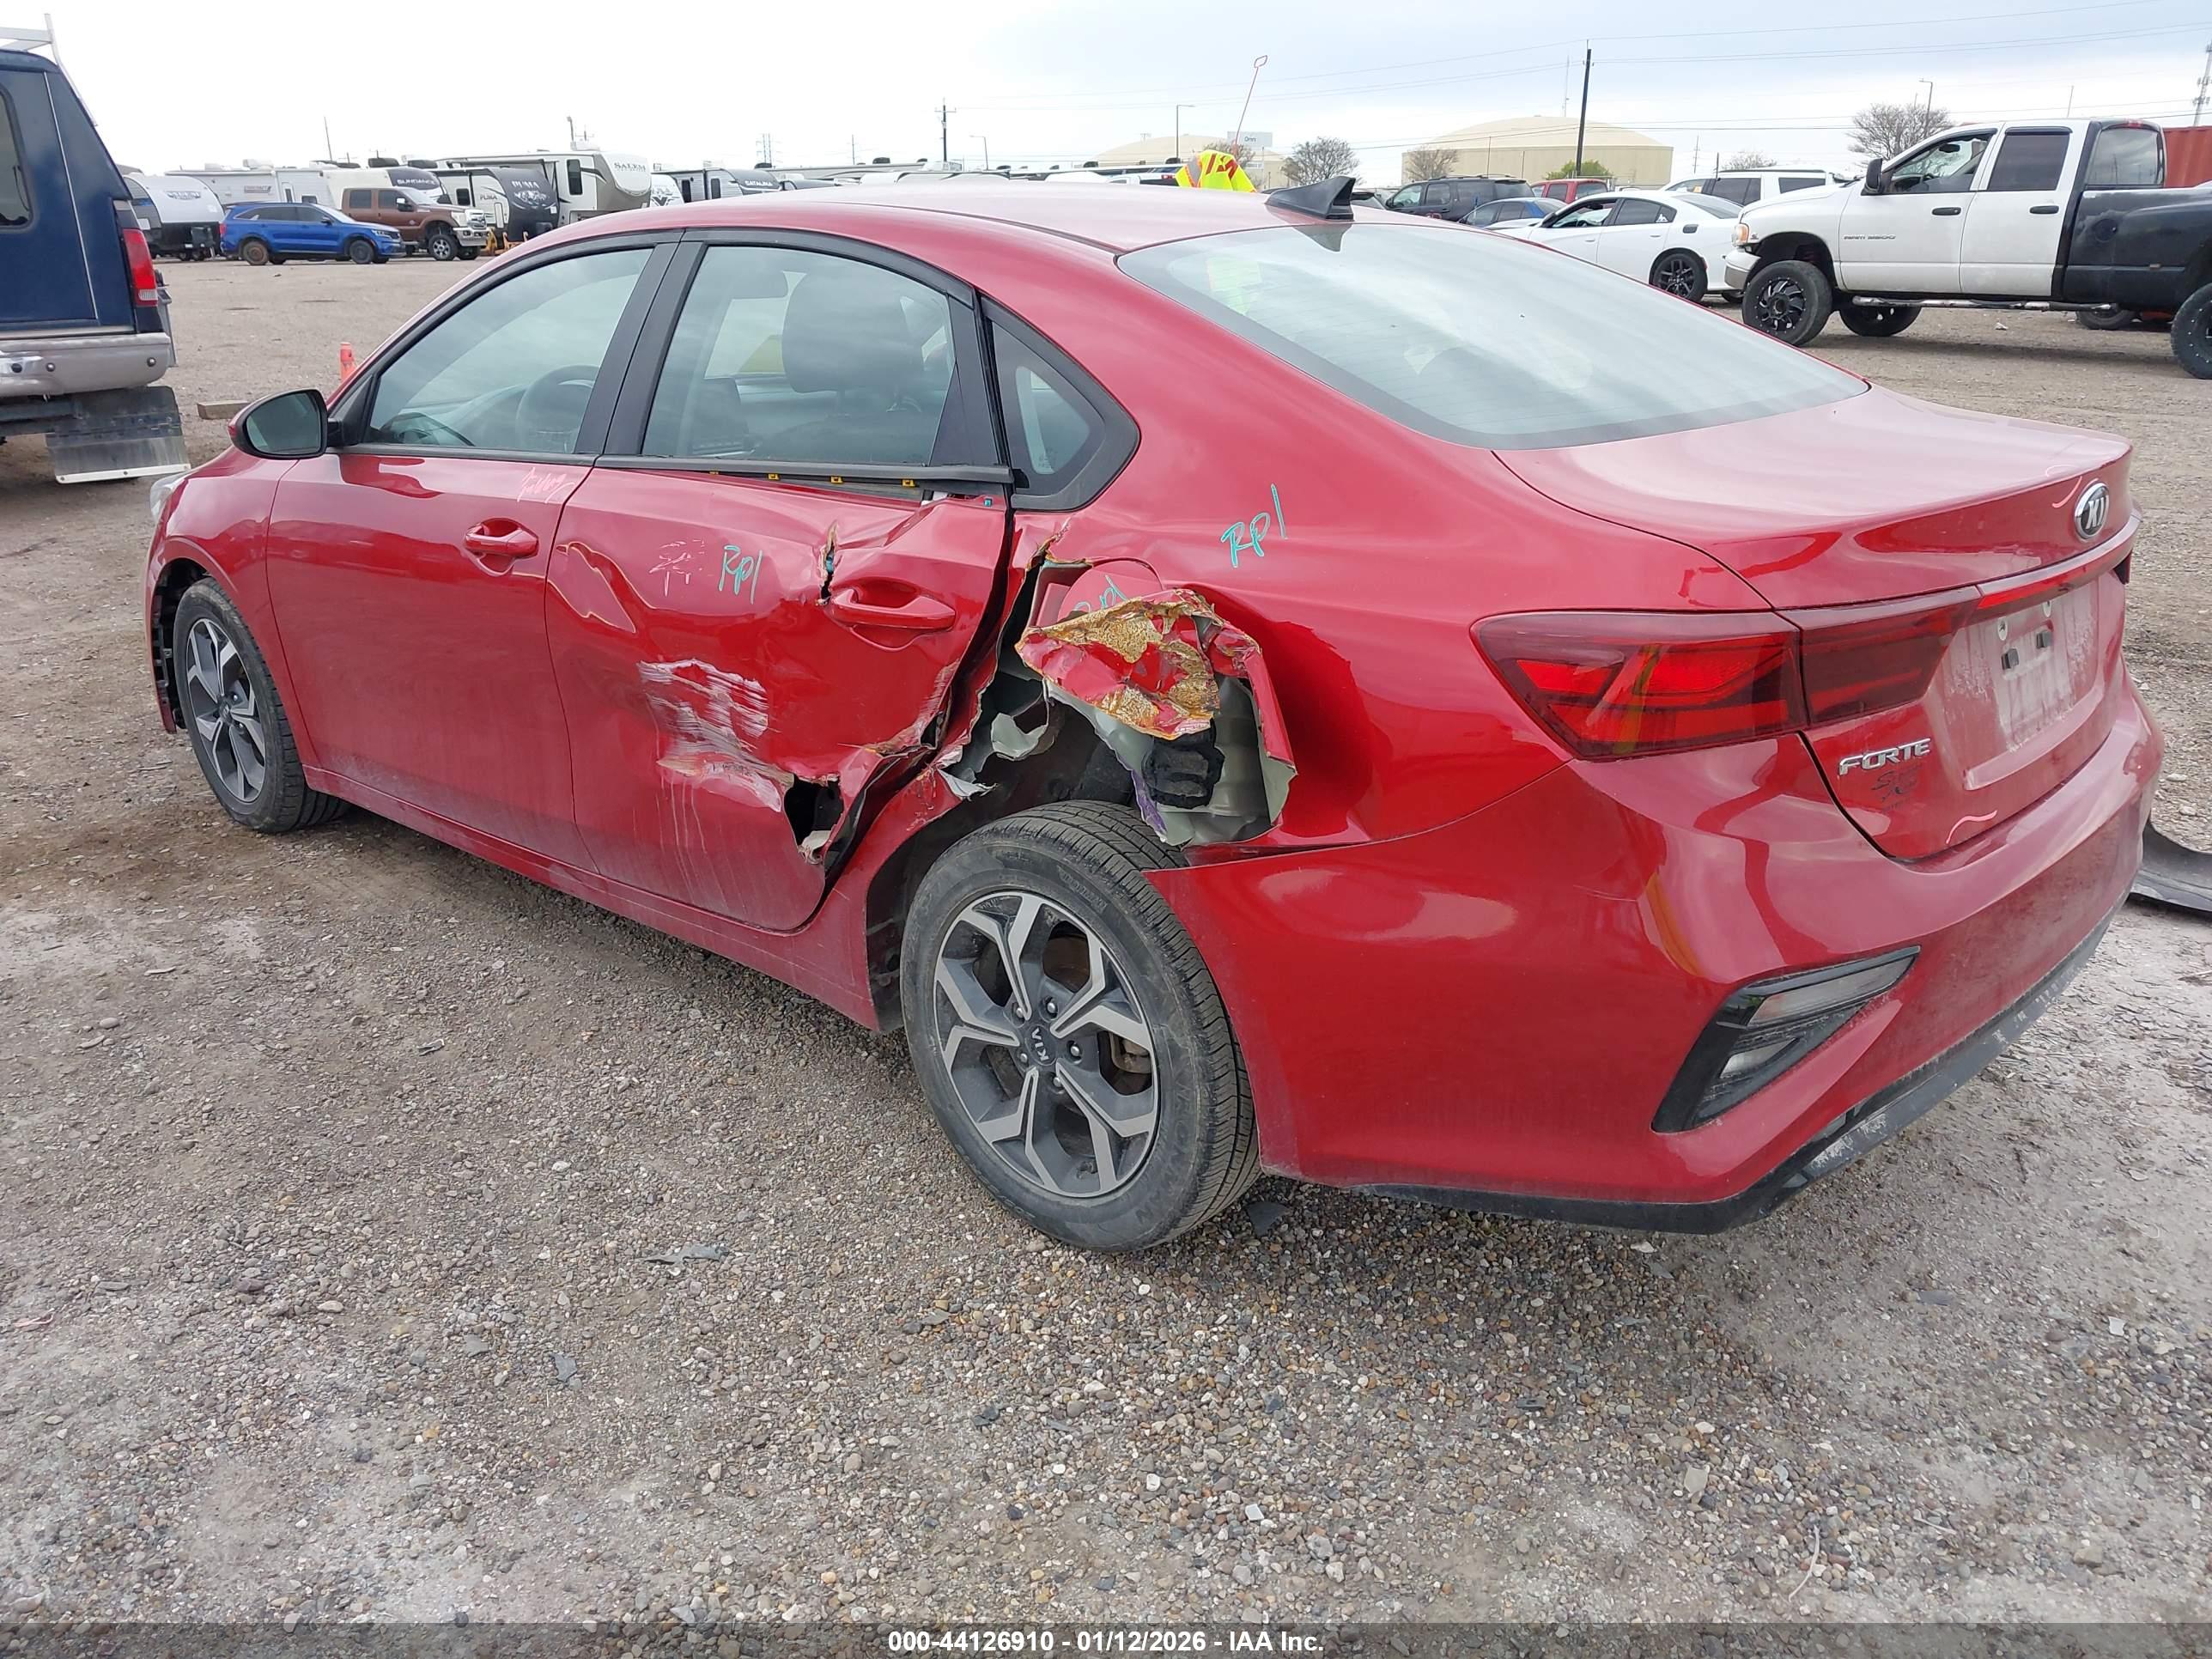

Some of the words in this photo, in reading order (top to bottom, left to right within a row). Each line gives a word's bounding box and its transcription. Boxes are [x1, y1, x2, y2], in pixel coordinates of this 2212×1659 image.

[613, 162, 647, 172] SALEM
[1838, 738, 1931, 776] FORTE
[1031, 1027, 1049, 1061] KIA
